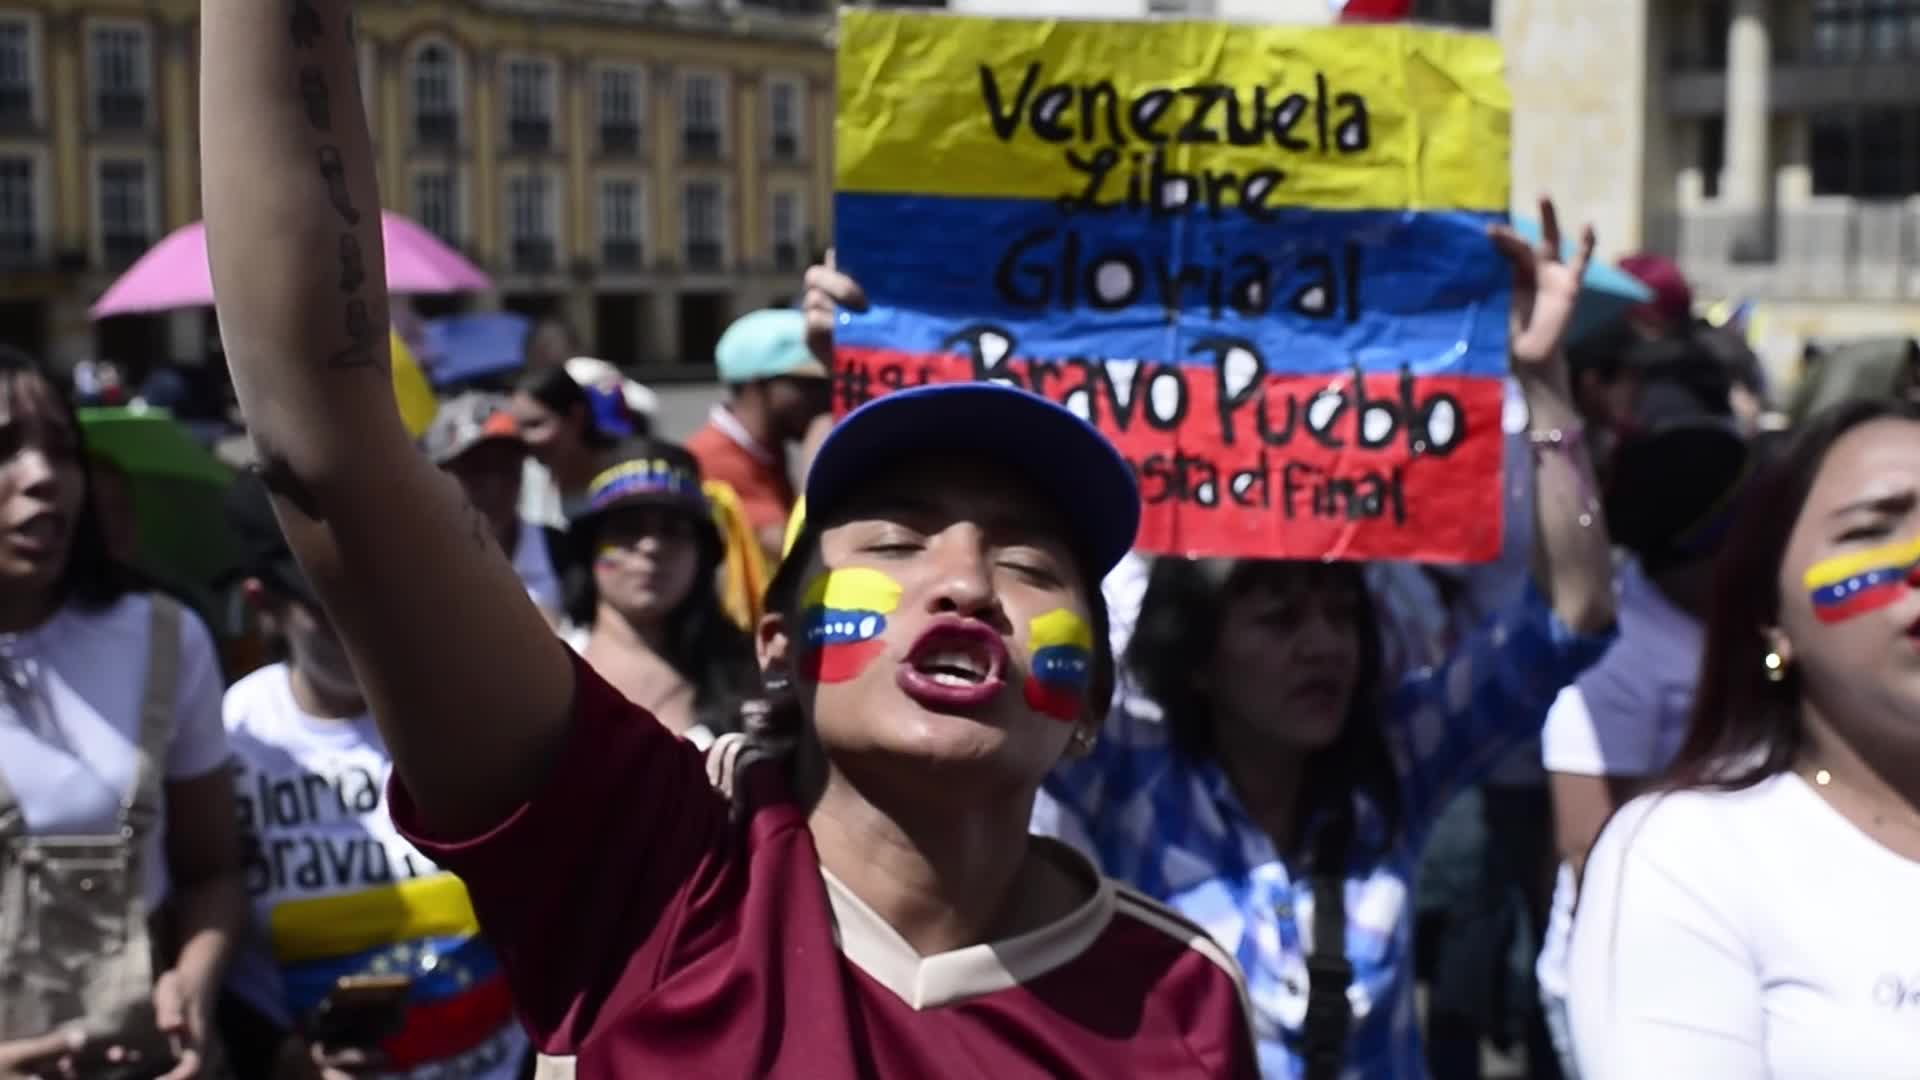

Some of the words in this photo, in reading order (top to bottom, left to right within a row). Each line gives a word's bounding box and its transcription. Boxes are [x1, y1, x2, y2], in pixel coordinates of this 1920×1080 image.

[978, 61, 1371, 154] Venezuela
[1056, 147, 1286, 221] Libre
[994, 228, 1271, 322] Gloria
[1287, 240, 1362, 324] al
[1190, 337, 1464, 456] Pueblo
[1231, 450, 1269, 510] el
